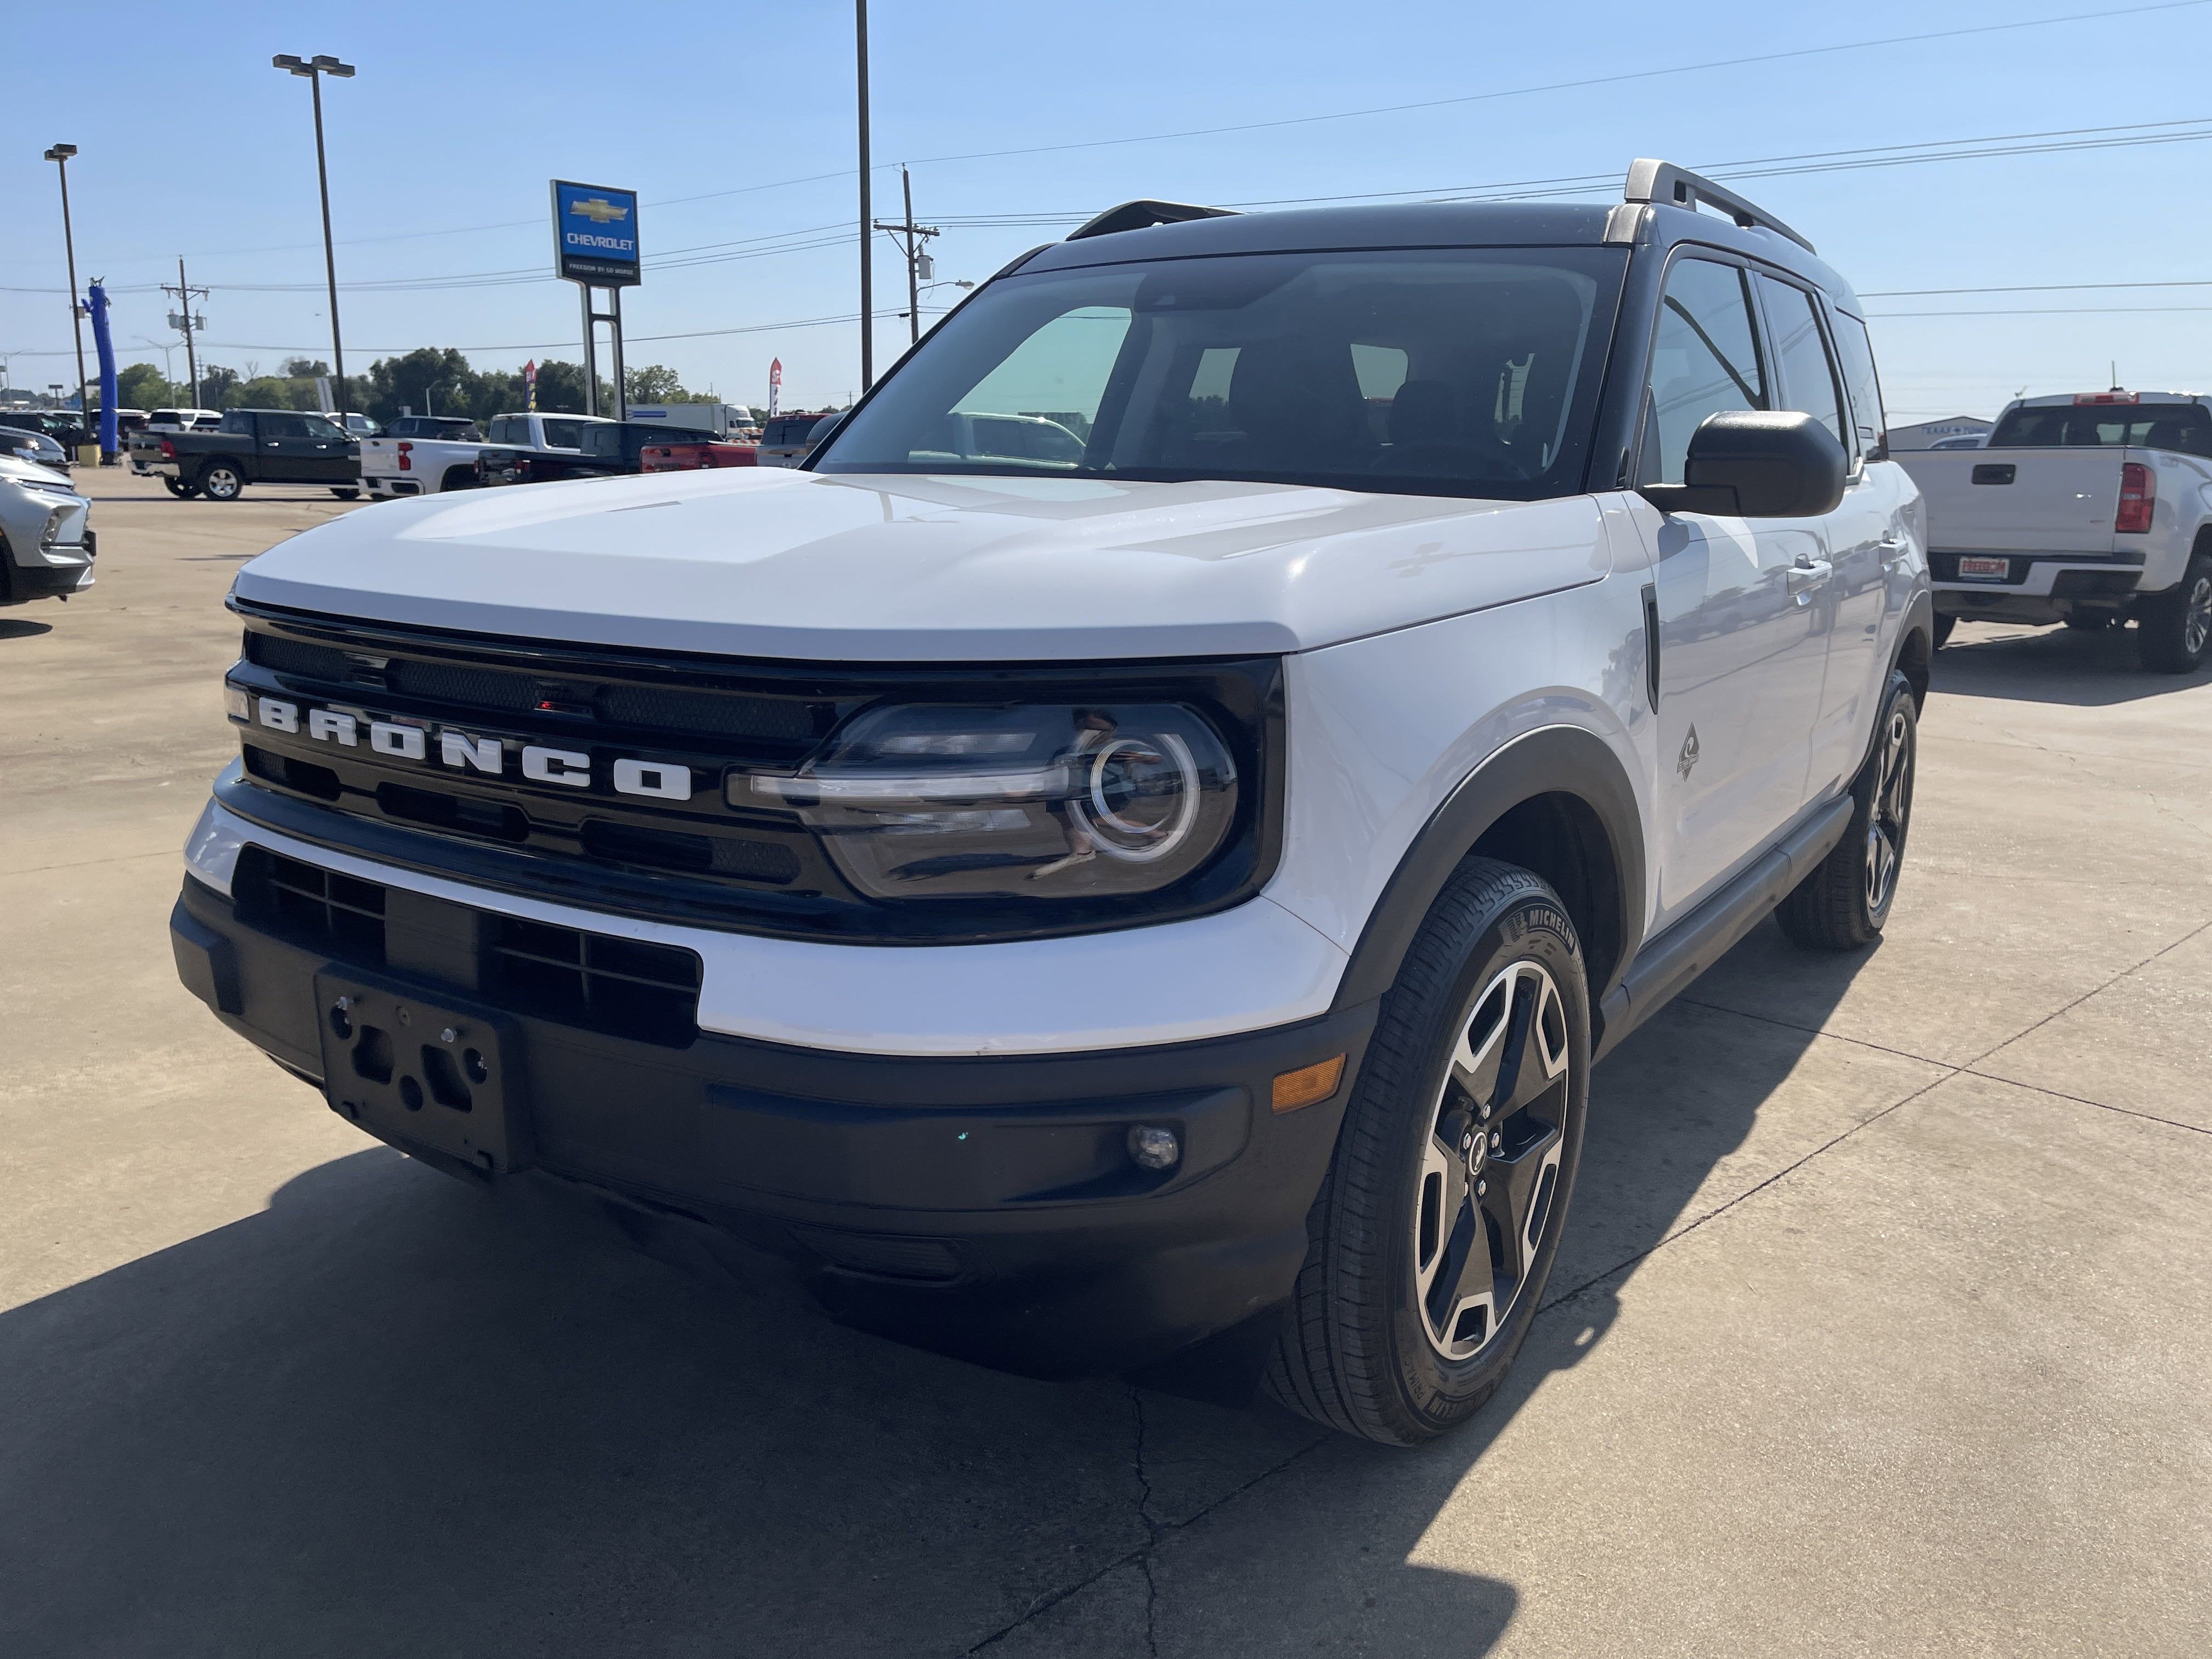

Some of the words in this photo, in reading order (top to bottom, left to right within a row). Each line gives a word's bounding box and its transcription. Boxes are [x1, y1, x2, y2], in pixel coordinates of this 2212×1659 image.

[567, 233, 634, 251] CHEVROLET
[258, 696, 692, 801] BRONCO
[1529, 909, 1575, 950] MICHELIN
